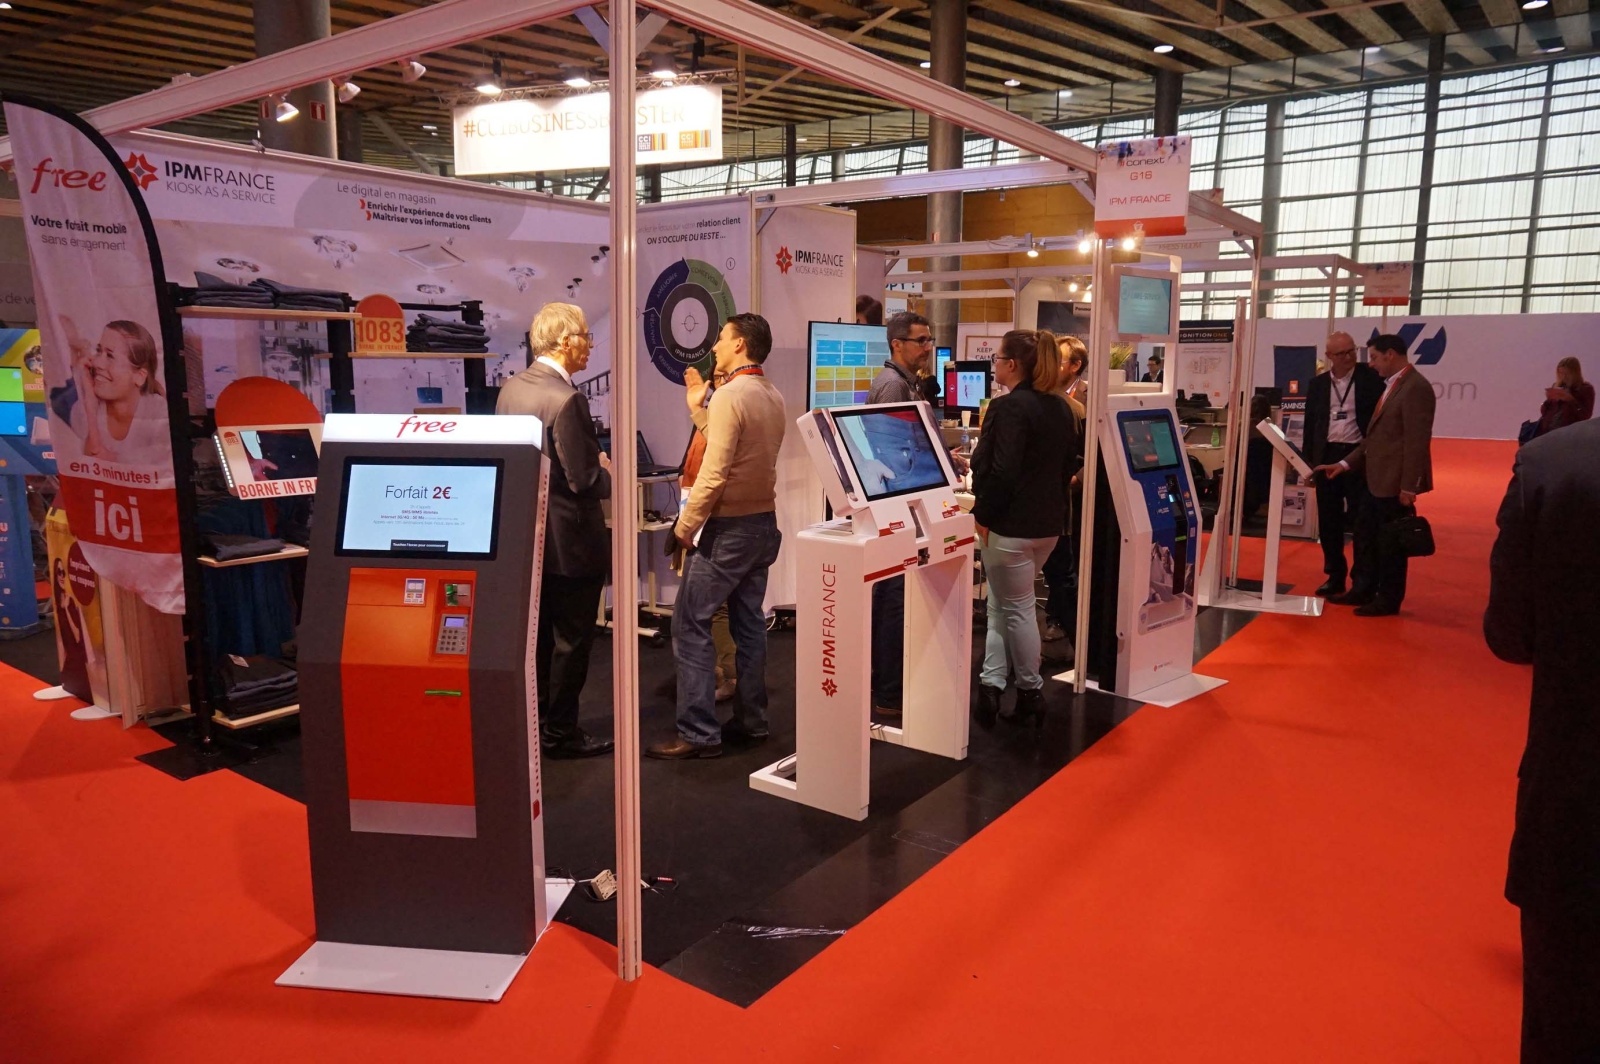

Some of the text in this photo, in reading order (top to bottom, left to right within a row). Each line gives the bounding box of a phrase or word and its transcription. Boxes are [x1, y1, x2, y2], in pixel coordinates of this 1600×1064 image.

[462, 105, 685, 138] #CCIBUSINESSBSTER
[30, 157, 107, 194] free
[164, 160, 275, 191] IPMFRANCE
[166, 181, 276, 205] KIOSK AS A SERVICE
[337, 182, 436, 206] Le digital en magasin
[1109, 194, 1172, 206] IPM FRANCE
[367, 201, 492, 224] Enrichir l'expérience de vos clients
[372, 211, 470, 230] Maîtriser vos informations
[696, 218, 722, 228] relation
[722, 216, 741, 226] client
[31, 214, 62, 229] Votre
[65, 219, 90, 232] foait
[42, 234, 126, 252] sans enagement
[647, 237, 656, 245] ON
[658, 234, 688, 244] S'OCCUPE
[688, 233, 700, 242] DU
[794, 249, 844, 268] IPMFRANCE
[795, 266, 811, 274] KIOSK
[824, 268, 844, 278] SERVICE
[356, 320, 404, 344] 1083
[674, 348, 705, 359] IPM FRANCE
[396, 415, 458, 438] free
[70, 462, 159, 485] en 3 minutes !
[238, 479, 318, 498] BORNE IN FR
[385, 485, 452, 500] Forfait 2€
[94, 488, 144, 543] ici
[70, 558, 91, 572] Imprimez
[77, 576, 96, 588] coupons
[822, 562, 837, 676] IPMFRANCE
